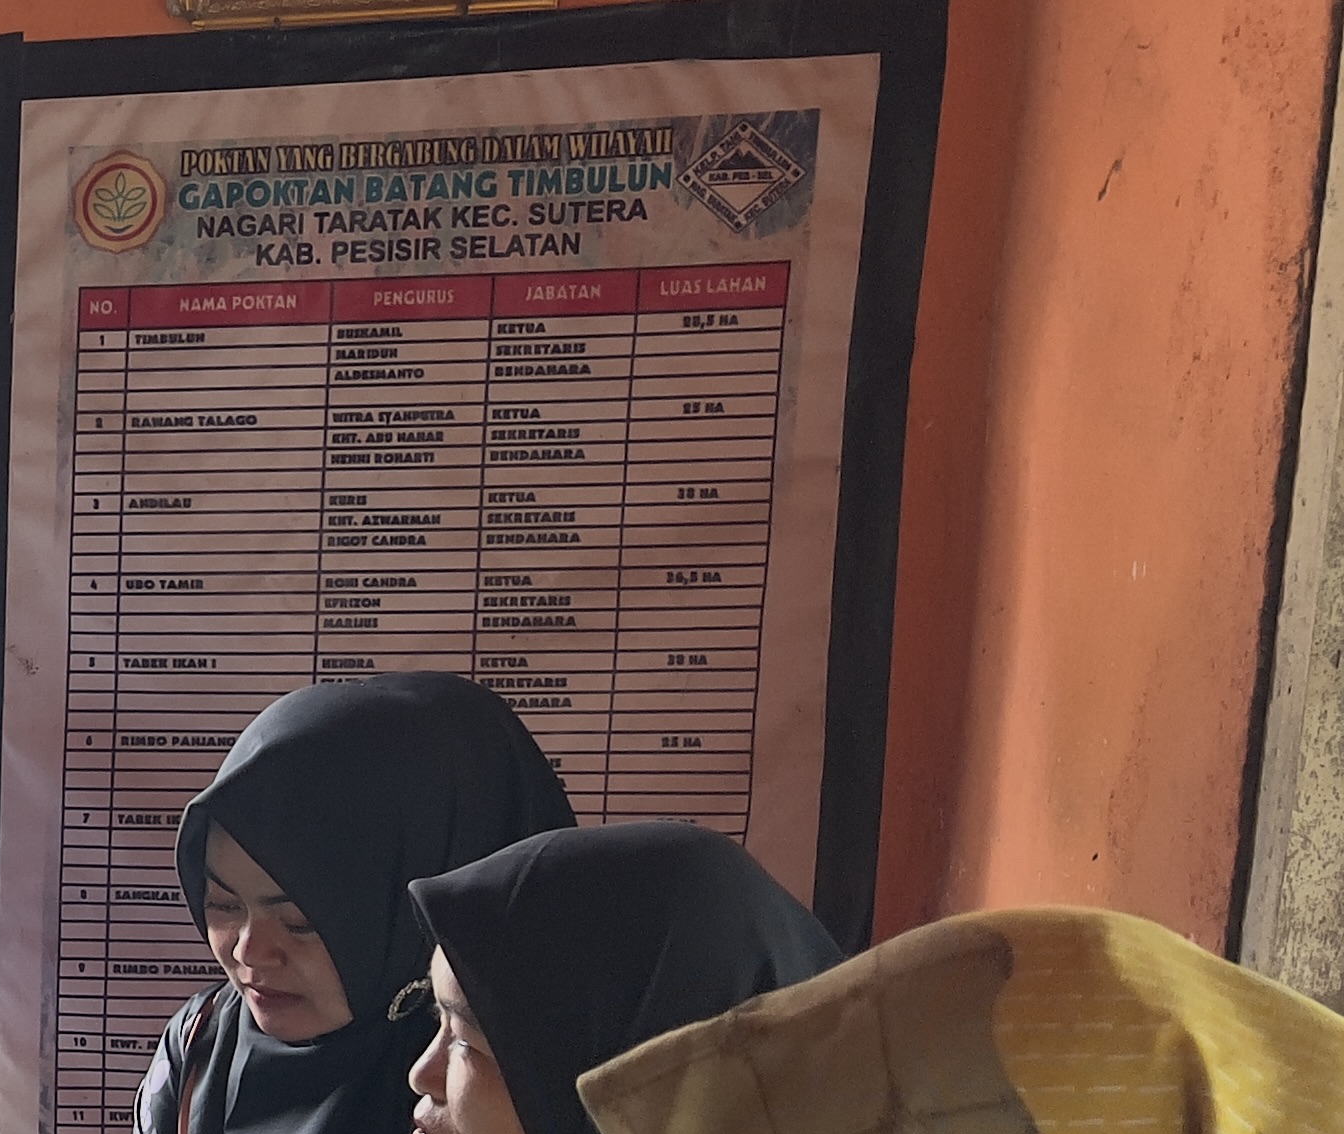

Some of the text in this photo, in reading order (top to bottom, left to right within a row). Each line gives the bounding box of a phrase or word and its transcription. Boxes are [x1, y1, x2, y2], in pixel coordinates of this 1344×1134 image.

[180, 126, 674, 177] POKTAN YANG BERGABUNG DALAM WILAYAH
[178, 177, 356, 211] GAPOKTAN
[362, 169, 497, 205] BATANG
[502, 161, 673, 198] TIMBULUN
[196, 198, 648, 239] NAGARI TARATAK KEC. SUTERA
[255, 231, 581, 267] KAB. PESISIR SELATAN
[89, 276, 767, 315] NO. NAMA POKTAN PENGURUS JABATAN LUAS LAHAN
[99, 314, 738, 346] 1 TIMBULUN BUSKAMIL KETUA HA
[335, 343, 586, 360] MARIDUN SEKRETARIS
[334, 363, 591, 381] ALDESMANTO BENDAHARA
[131, 416, 193, 428] RAWANG
[197, 414, 258, 427] TALAGO
[332, 412, 374, 424] WITRA
[491, 408, 541, 420] KETUA
[705, 402, 725, 413] HA
[490, 427, 580, 440] SEKRETARIS
[490, 448, 586, 462] BENDAHARA
[128, 496, 192, 509] ANDILAU
[488, 490, 536, 503] KETUA
[699, 487, 718, 499] HA
[362, 513, 441, 526] AZWARMAN
[487, 511, 576, 525] SEKRETARIS
[371, 534, 426, 547] CANDRA
[486, 531, 581, 545] BENDAHARA
[126, 578, 155, 590] UBO
[159, 578, 204, 590] TAMIR
[362, 576, 417, 588] CANDRA
[484, 575, 532, 587] KETUA
[703, 571, 722, 583] HA
[483, 594, 571, 608] SEKRETARIS
[482, 615, 577, 628] BENDAHARA
[123, 657, 168, 669] TABEK
[172, 656, 207, 669] IKAN
[321, 657, 375, 669] HENDRA
[480, 656, 528, 668] KETUA
[689, 654, 707, 665] HA
[120, 736, 167, 746] RIMBO
[683, 737, 702, 748] HA
[83, 813, 90, 824] 7
[118, 814, 162, 825] TABEK
[113, 964, 159, 975] RIMBO
[73, 1037, 87, 1048] 10
[110, 1039, 142, 1050] KWT.
[72, 1111, 85, 1121] 11
